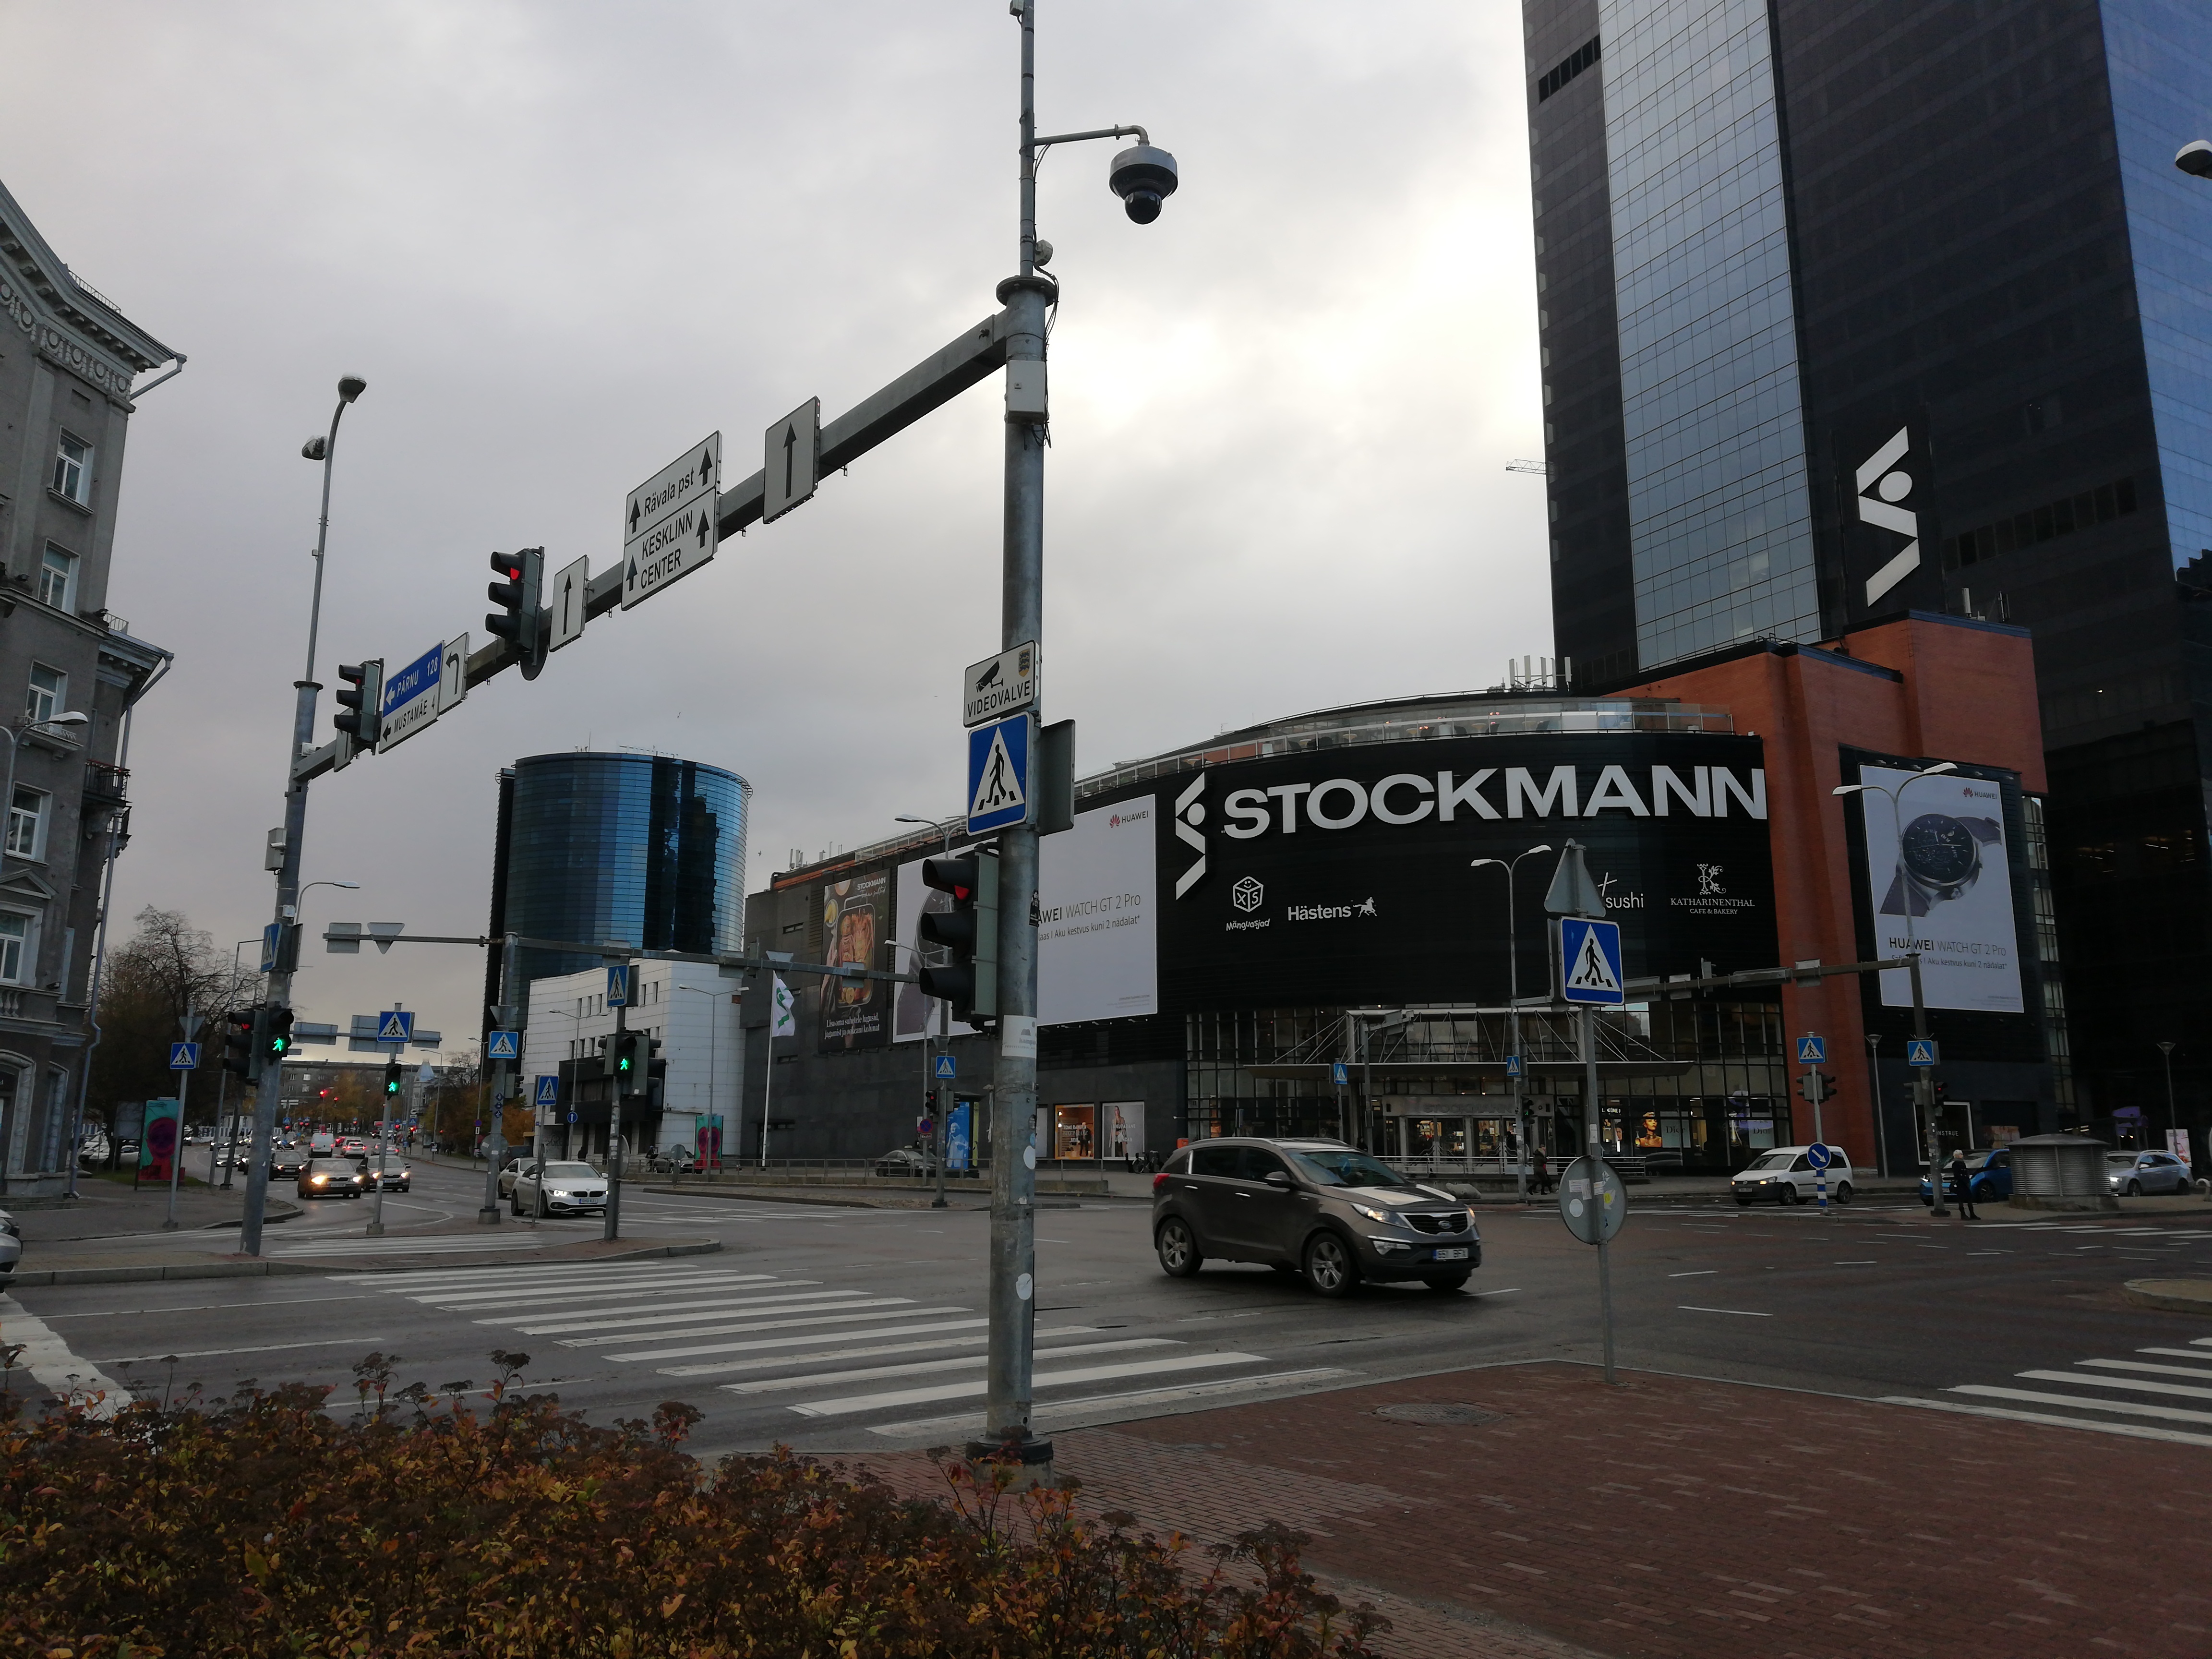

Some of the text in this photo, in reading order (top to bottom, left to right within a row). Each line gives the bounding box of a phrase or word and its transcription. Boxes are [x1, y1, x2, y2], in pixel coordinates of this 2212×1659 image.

[644, 467, 694, 517] Rävala pst
[642, 509, 693, 560] KESKLINN
[641, 548, 681, 589] CENTER
[397, 656, 438, 697] PÄRNU 128
[967, 680, 1031, 718] VIDEOVALVE
[393, 694, 435, 734] MUSTAMÄE 4
[1224, 765, 1768, 839] STOCKMANN
[1974, 791, 1997, 799] HUAWEI
[1121, 810, 1149, 824] HUAWEI
[857, 877, 886, 890] STOCKMANN
[1066, 899, 1097, 919] WATCH
[1100, 897, 1113, 912] GT
[1116, 895, 1121, 909] 2
[1125, 893, 1141, 908] Pro
[1606, 891, 1644, 908] sushi
[1670, 898, 1755, 907] KATHARINENTHAL
[1288, 904, 1352, 921] Hästens
[1055, 929, 1066, 938] Aku
[1068, 925, 1090, 936] kestvus
[1091, 921, 1104, 931] kuni
[1106, 920, 1110, 929] 2
[1226, 918, 1271, 931] Mänguasjad
[1937, 941, 1969, 953] WATCH
[1971, 943, 1982, 954] GT
[1985, 944, 1991, 955] 2
[1993, 944, 2007, 956] Pro
[1941, 958, 1962, 967] kestvus
